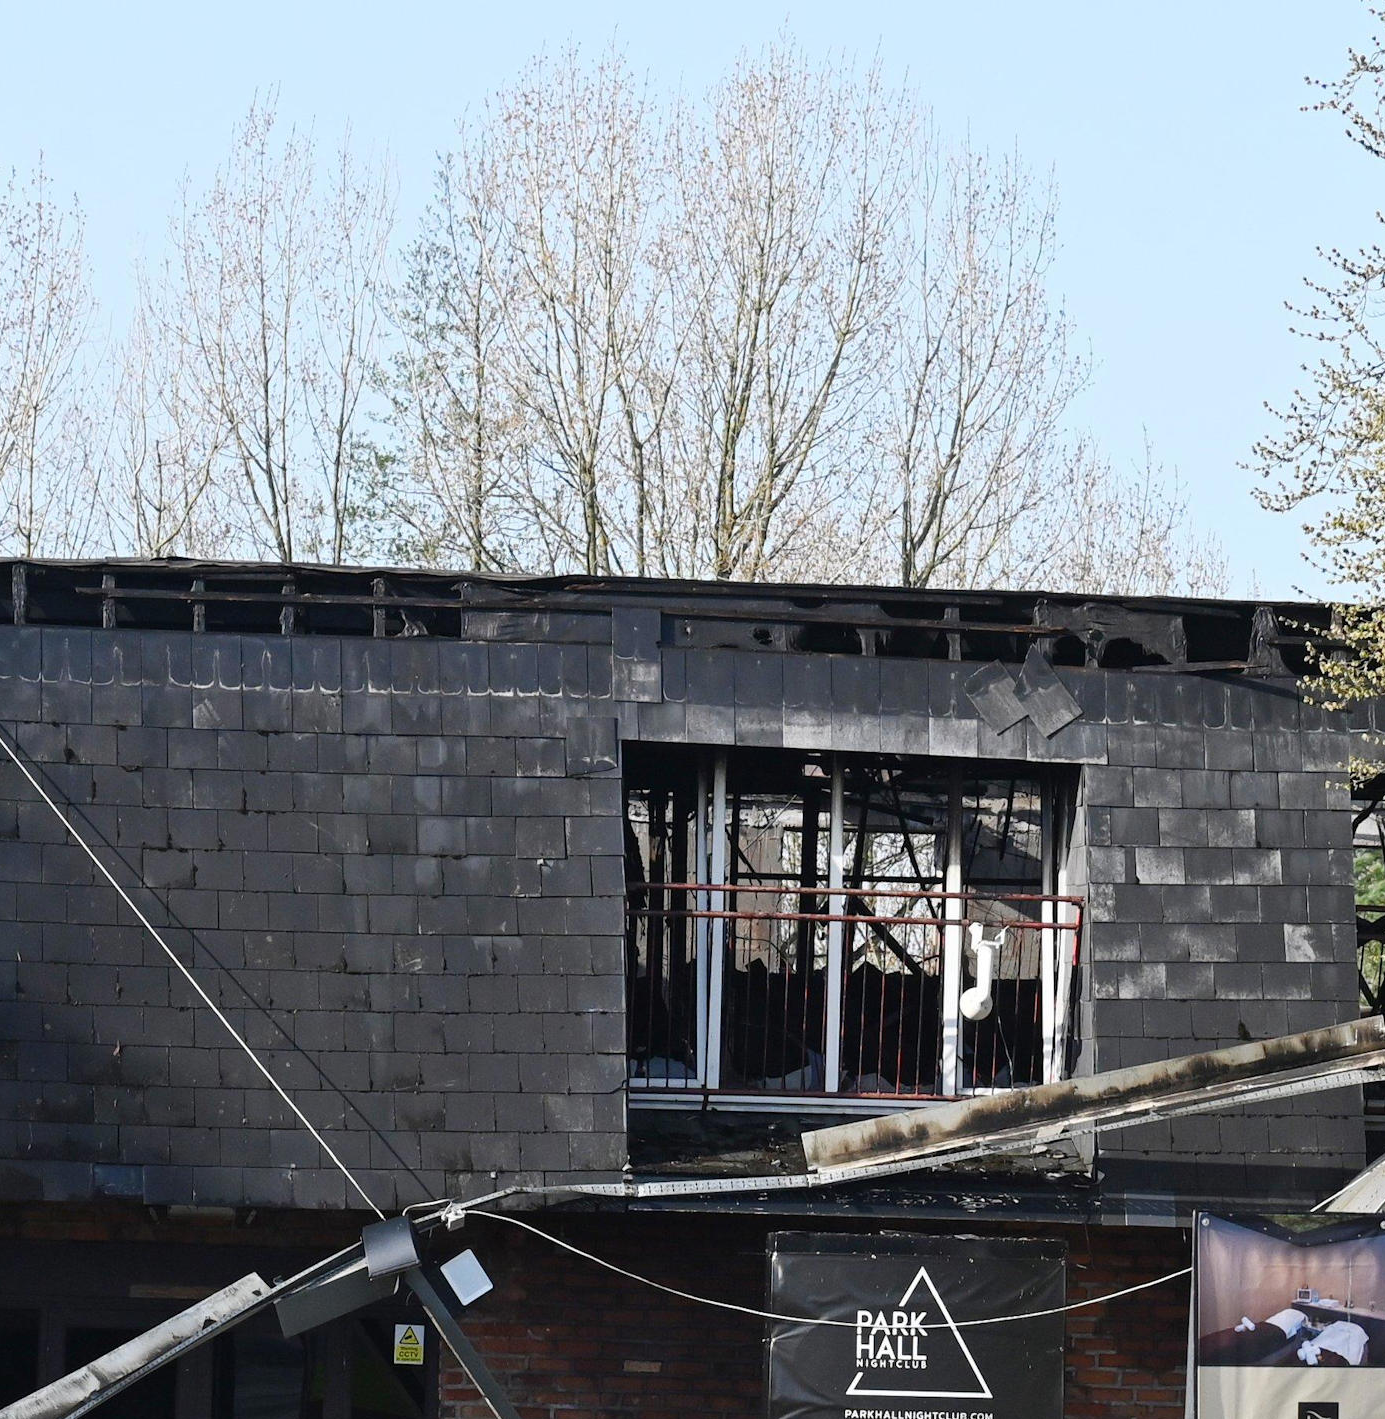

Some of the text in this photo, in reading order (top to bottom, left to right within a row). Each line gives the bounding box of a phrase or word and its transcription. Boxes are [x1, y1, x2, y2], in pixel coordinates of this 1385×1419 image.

[856, 1310, 928, 1336] PARK
[856, 1334, 927, 1361] HALL
[856, 1359, 927, 1369] NIGHTCLUB
